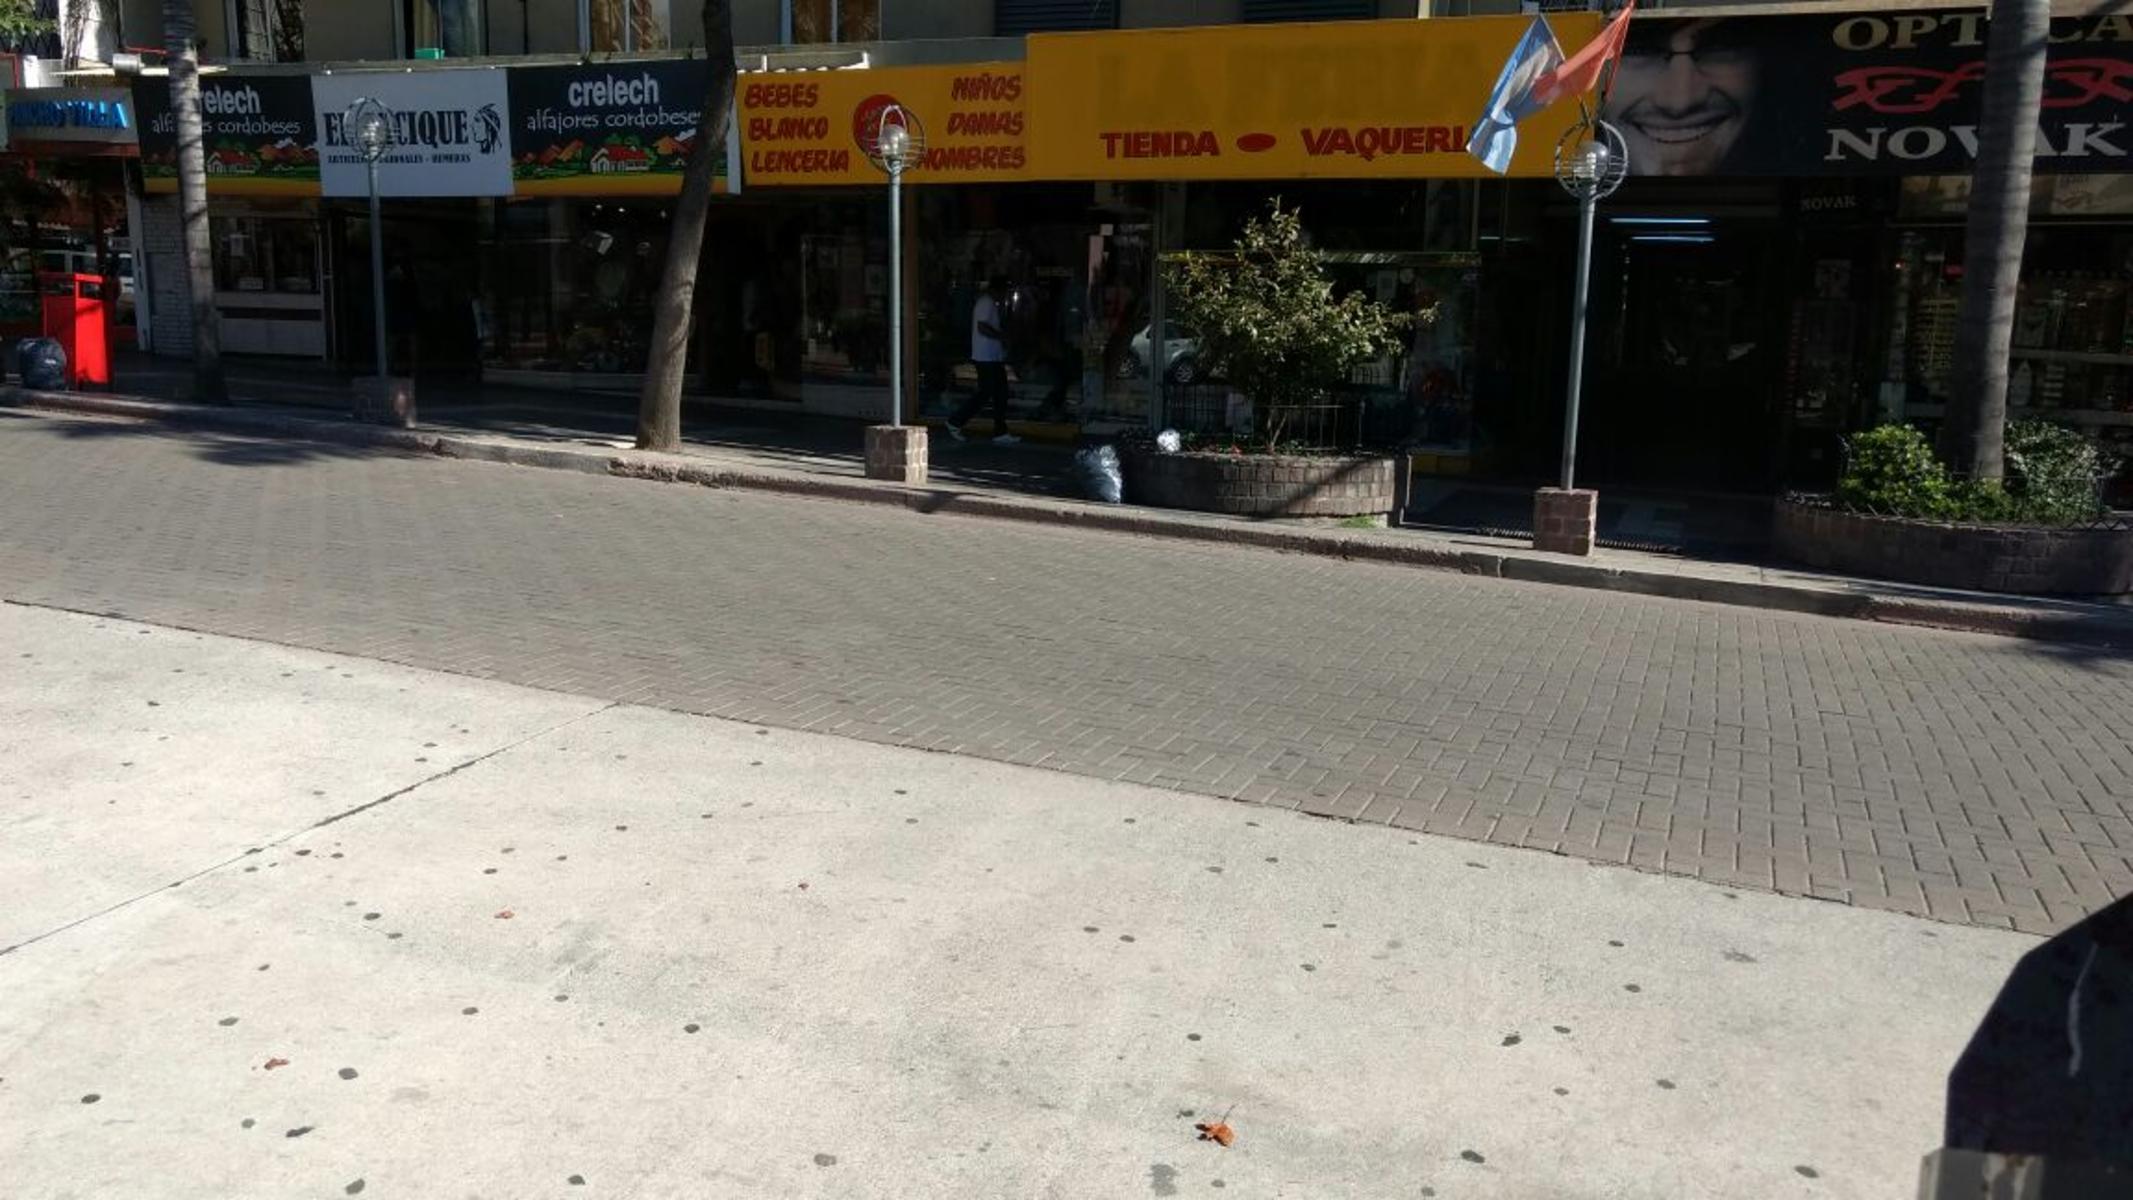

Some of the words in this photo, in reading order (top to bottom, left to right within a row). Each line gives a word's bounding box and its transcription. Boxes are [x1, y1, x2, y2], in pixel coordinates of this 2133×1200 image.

[1832, 14, 2133, 50] OPTCA
[198, 83, 262, 114] elech
[568, 73, 660, 107] crelech
[744, 83, 819, 108] BEBES
[951, 73, 1022, 101] NIÑOS
[218, 115, 300, 135] cordobeses
[358, 110, 469, 149] CIQUE
[527, 107, 599, 134] alfajores
[605, 105, 702, 128] cordobese
[748, 117, 829, 140] BLANCO
[947, 112, 1023, 136] DAMAS
[1100, 131, 1221, 159] TIENDA
[1301, 125, 1469, 161] VAQUERI
[378, 155, 423, 164] GIONALES
[751, 149, 849, 172] LENCERIA
